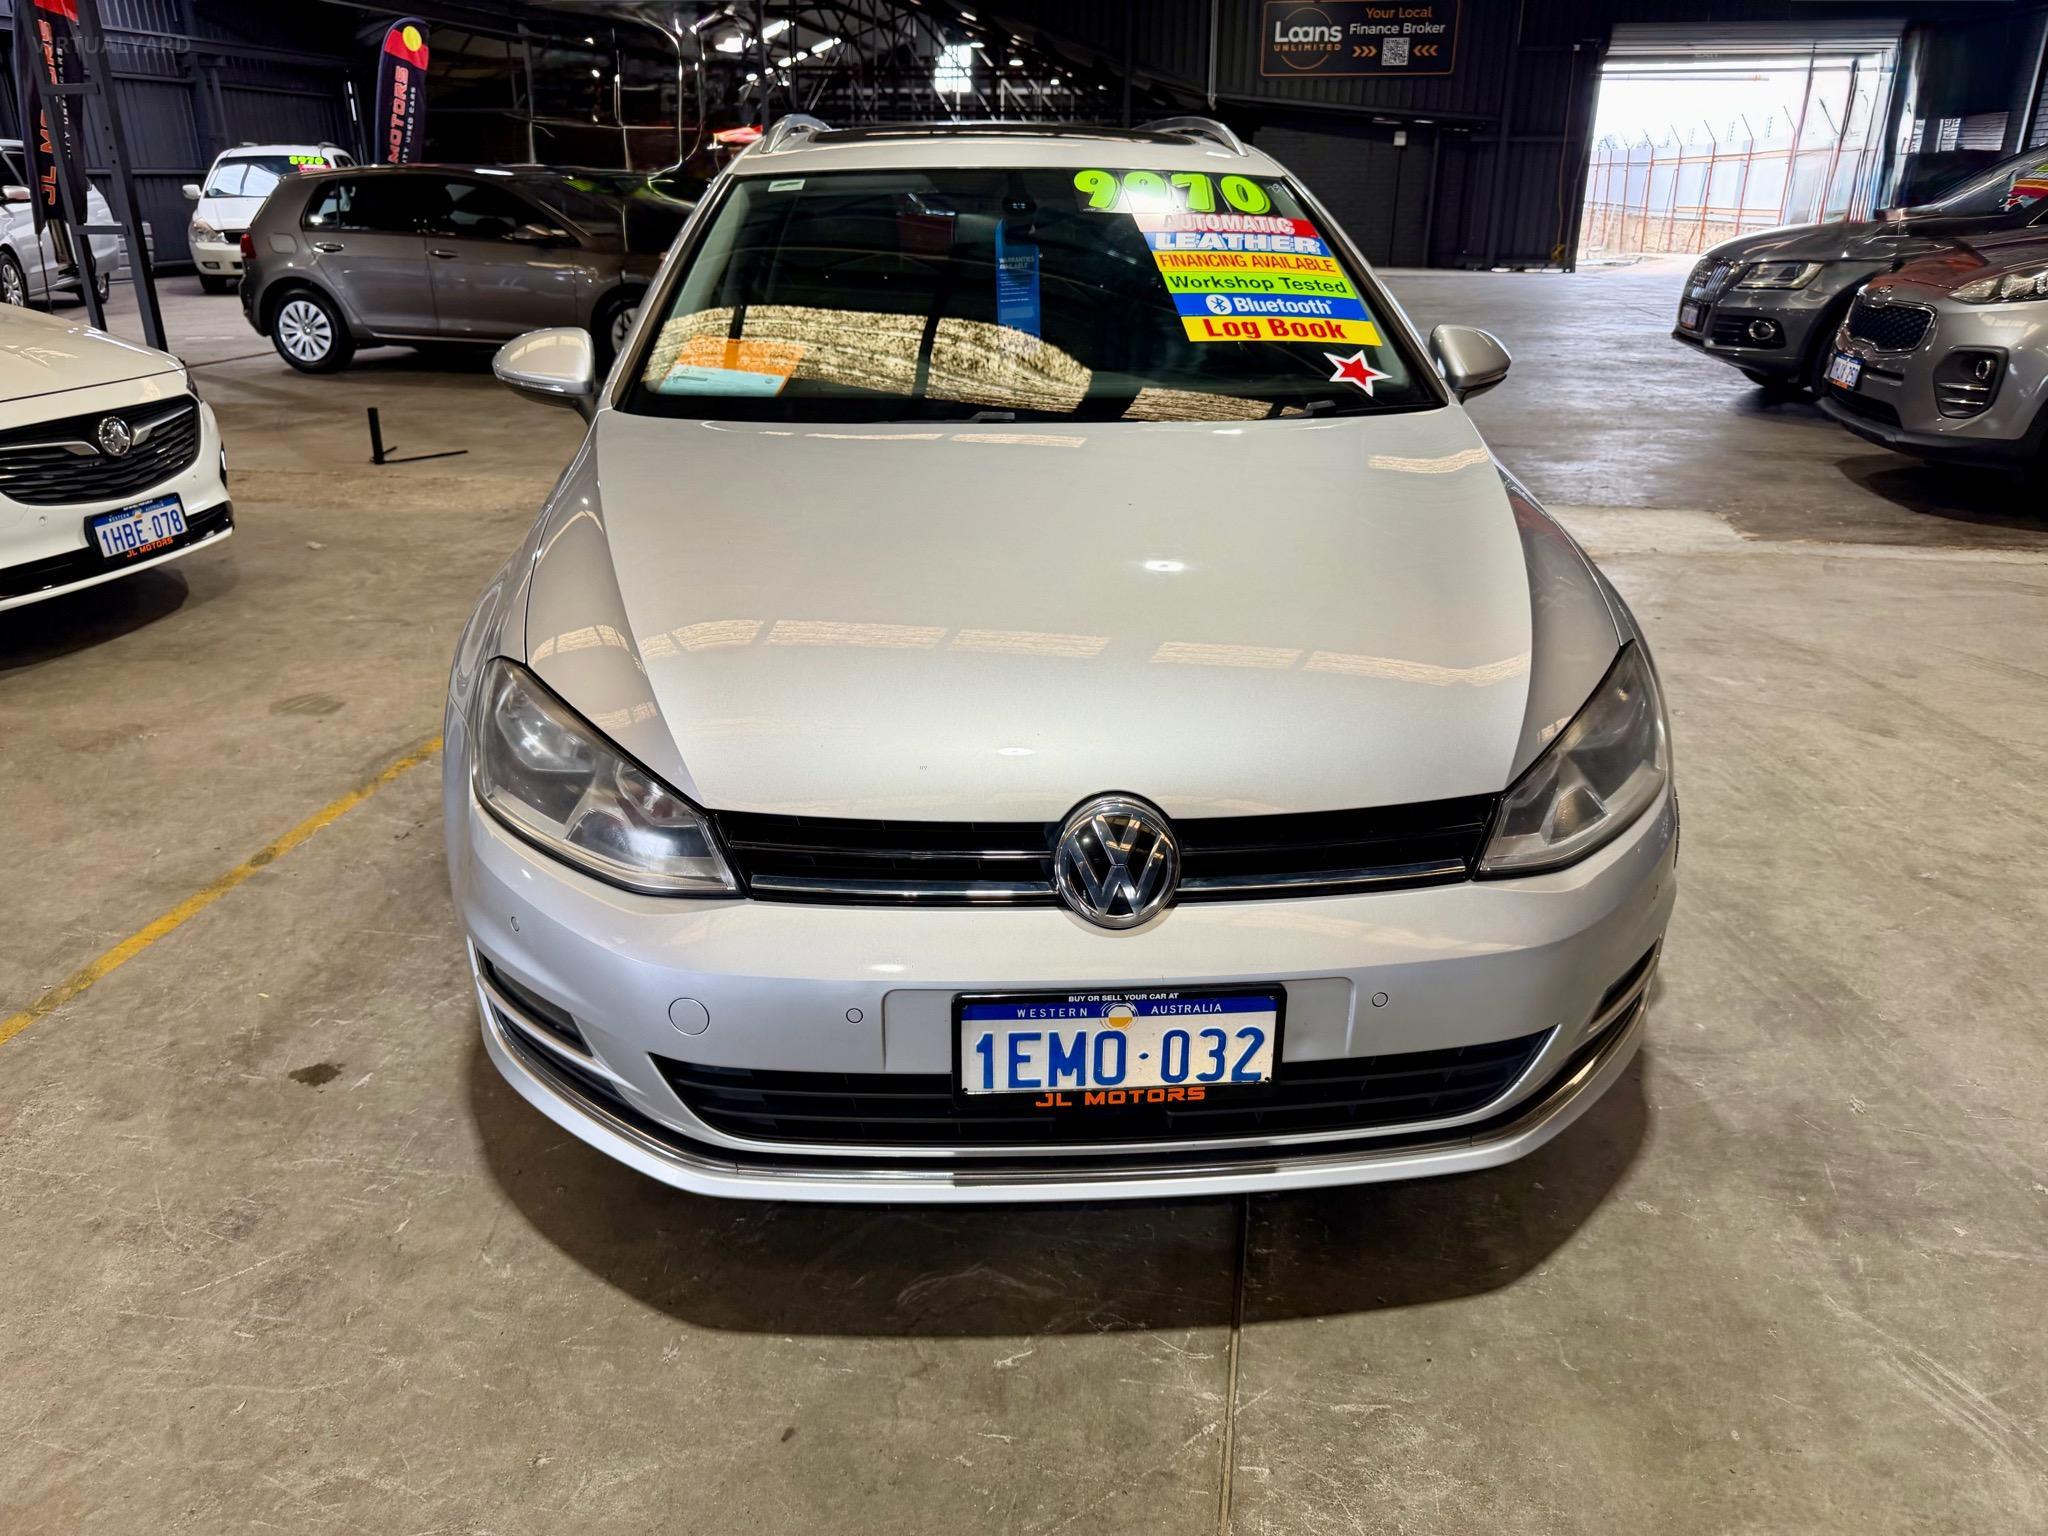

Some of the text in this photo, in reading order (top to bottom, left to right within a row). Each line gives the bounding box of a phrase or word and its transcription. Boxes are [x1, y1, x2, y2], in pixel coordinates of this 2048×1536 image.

[1366, 6, 1432, 19] Your Local
[1274, 21, 1343, 43] Loans
[1349, 22, 1446, 35] Finance Broker
[1273, 44, 1341, 52] UNLIMITED
[37, 19, 57, 205] JL MORS
[387, 65, 409, 164] MOTORS
[1073, 169, 1271, 214] 9970
[1164, 214, 1296, 235] AUTOMATIC
[1155, 232, 1322, 255] LEATHER
[1159, 254, 1337, 273] FINANCING AVAILABLE
[1169, 275, 1348, 294] Workshop Tested
[1202, 318, 1348, 339] Log Book
[1124, 993, 1147, 1001] YOUR
[1016, 1003, 1222, 1018] WESTERN AUSTRALIA
[1035, 1086, 1206, 1107] JL MOTORS
